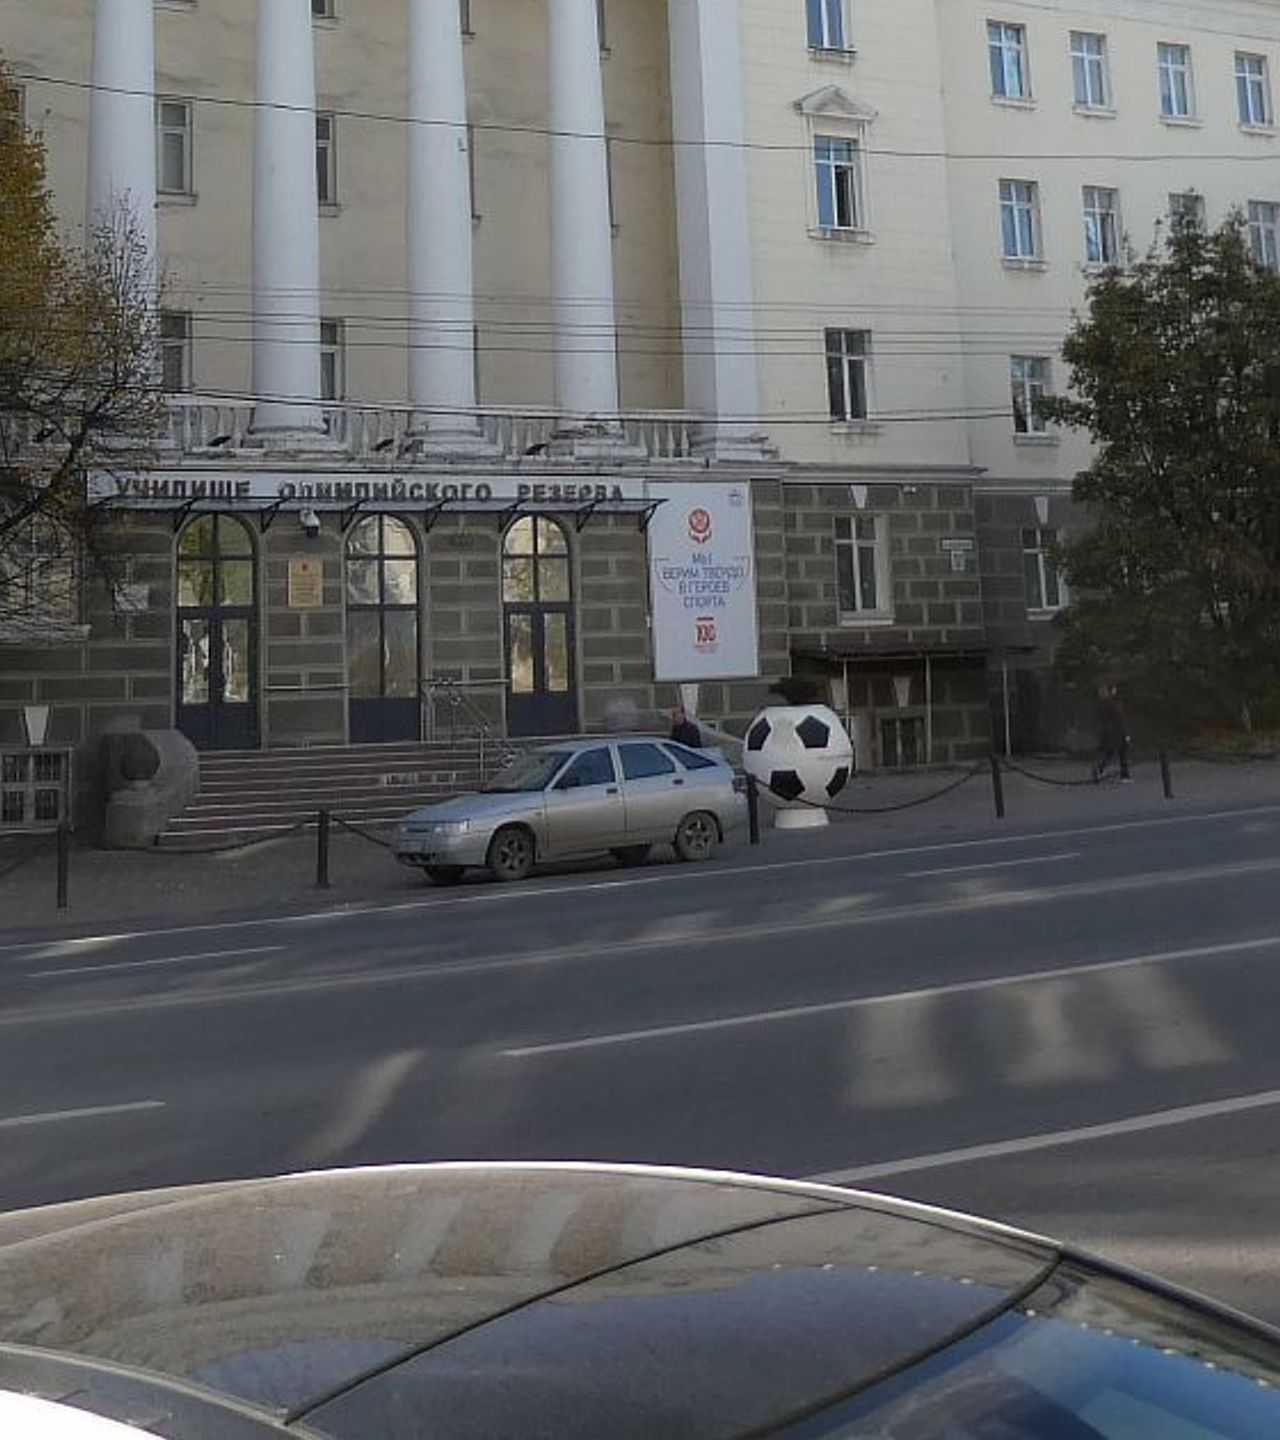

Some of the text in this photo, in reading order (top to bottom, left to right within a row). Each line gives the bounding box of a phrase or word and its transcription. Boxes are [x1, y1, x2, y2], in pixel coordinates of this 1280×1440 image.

[116, 478, 624, 502] УЧИЛИЩЕ ОЛИМПИЙСКОГО РЕЗЕРВА
